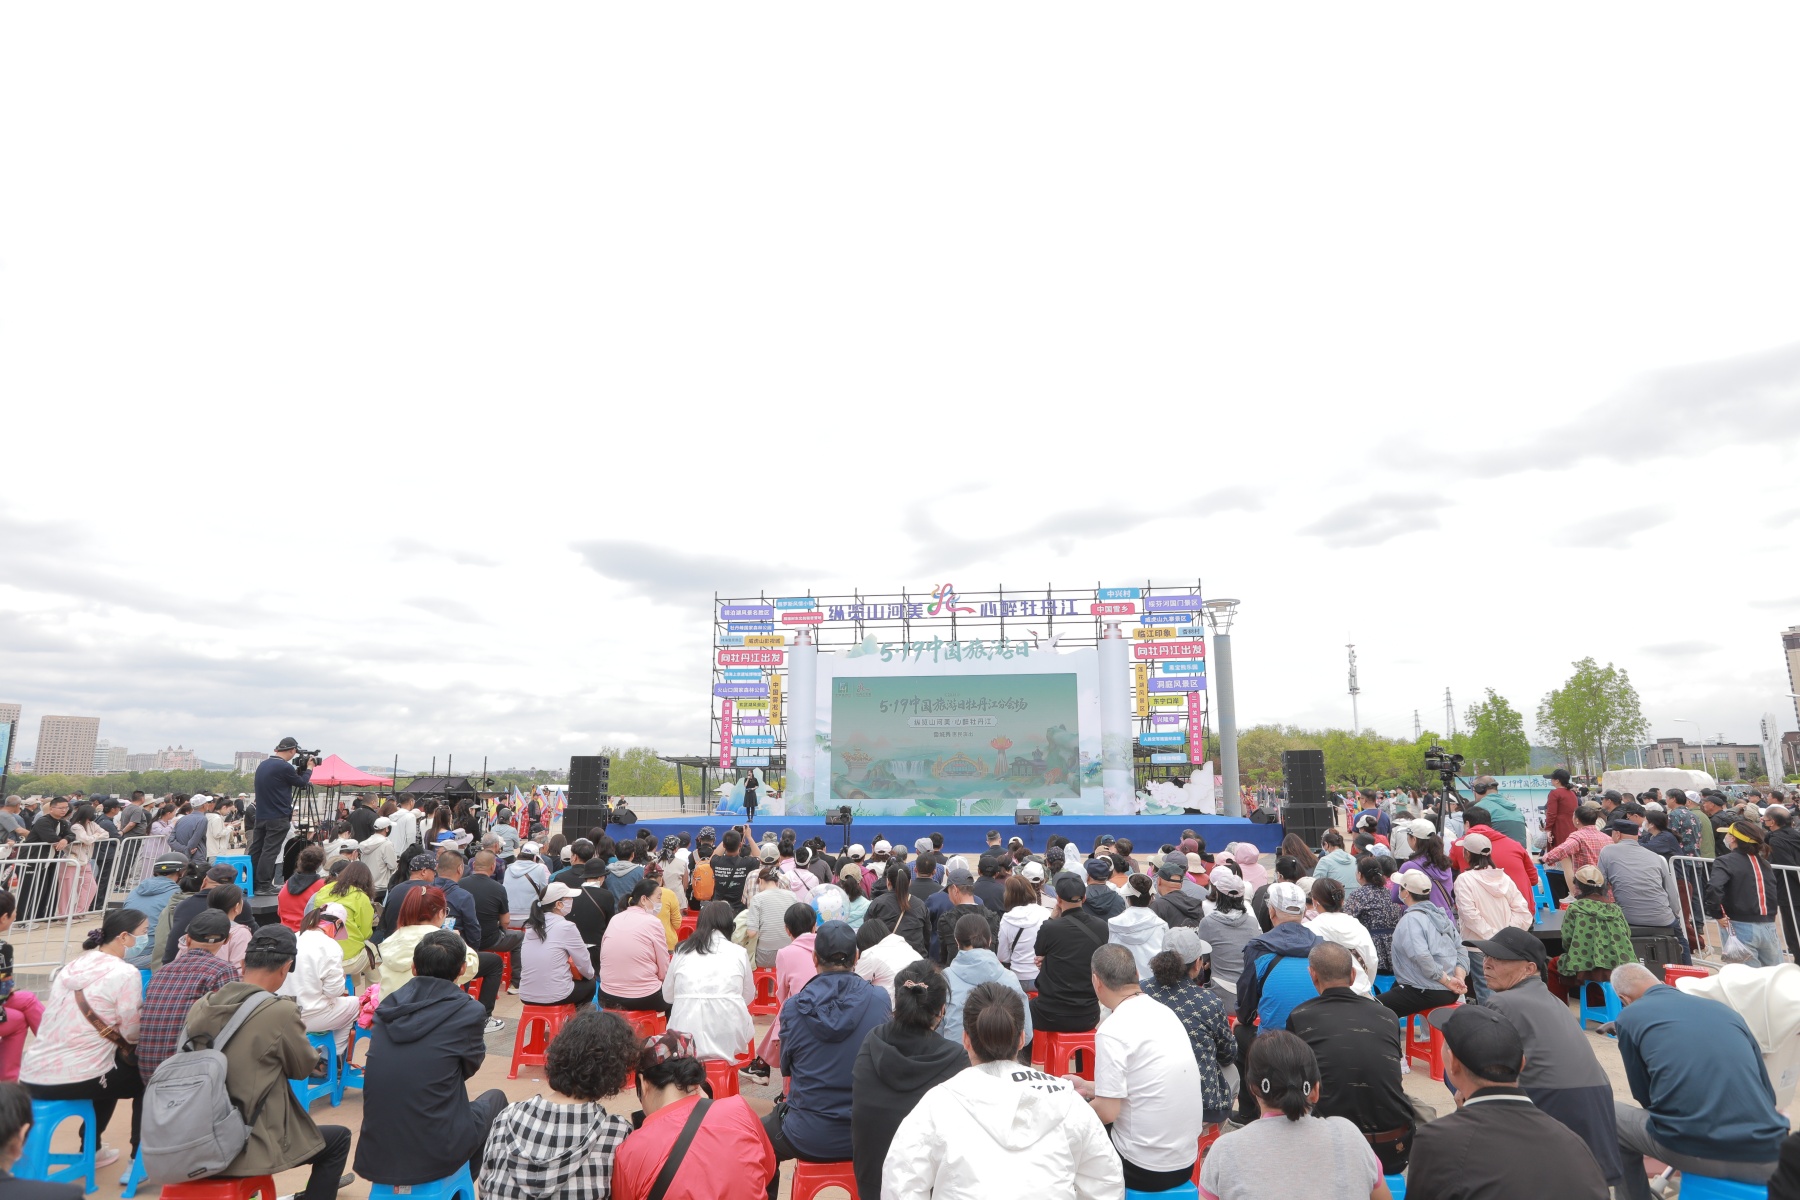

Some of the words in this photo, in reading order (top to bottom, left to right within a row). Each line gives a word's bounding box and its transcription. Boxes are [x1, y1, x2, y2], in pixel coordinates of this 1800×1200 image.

[1107, 590, 1131, 598] 中兴村
[1148, 599, 1198, 608] 绥芬河国门景区
[828, 602, 923, 621] 纵览山河美
[980, 599, 1078, 617] 心醉牡丹江
[1096, 605, 1129, 613] 中国雪乡
[1137, 629, 1171, 638] 临江印象
[1137, 645, 1202, 656] 向牡丹江出发
[721, 653, 780, 663] 向牡丹江出发
[1156, 680, 1198, 689] 洞庭风景区
[1153, 697, 1179, 705] 东宁口岸
